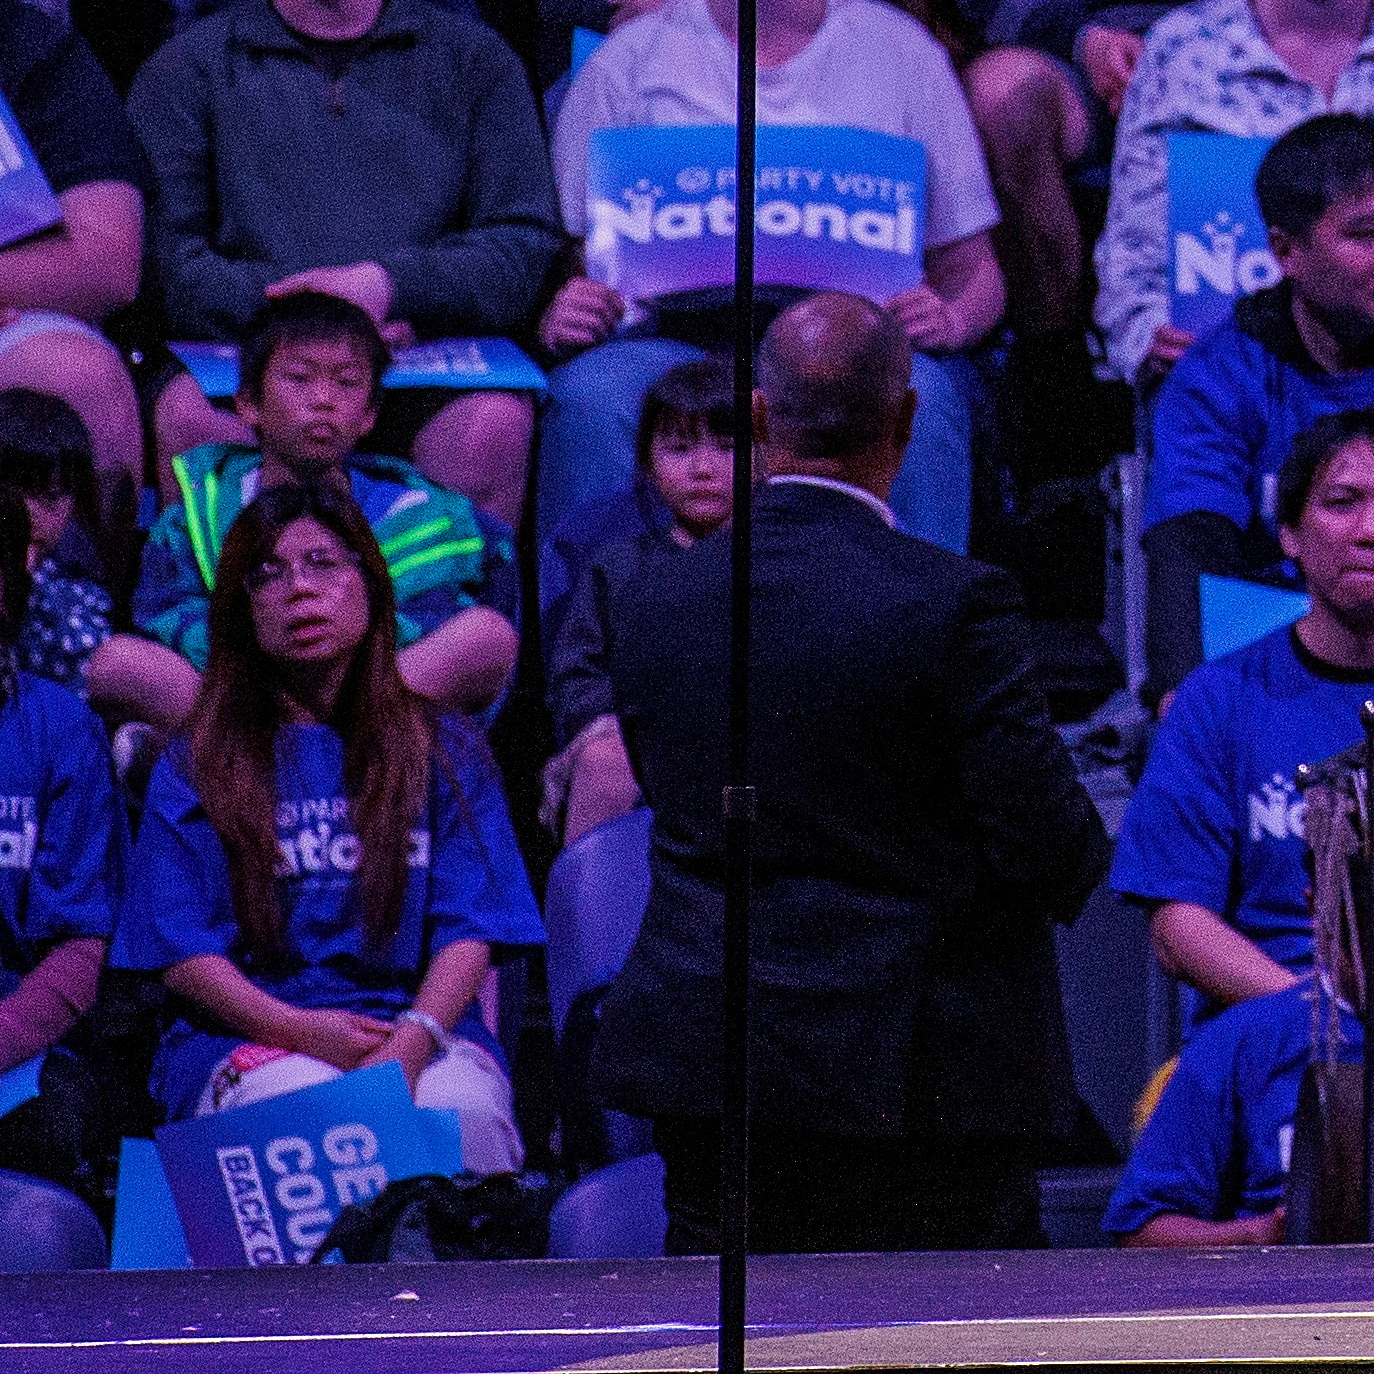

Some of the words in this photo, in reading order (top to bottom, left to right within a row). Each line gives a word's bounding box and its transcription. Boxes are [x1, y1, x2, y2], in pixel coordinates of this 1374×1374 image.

[716, 167, 822, 193] PRTY
[833, 172, 916, 202] VOTE
[592, 195, 917, 256] Natonal
[302, 796, 349, 822] PAR
[322, 1123, 389, 1206] GE
